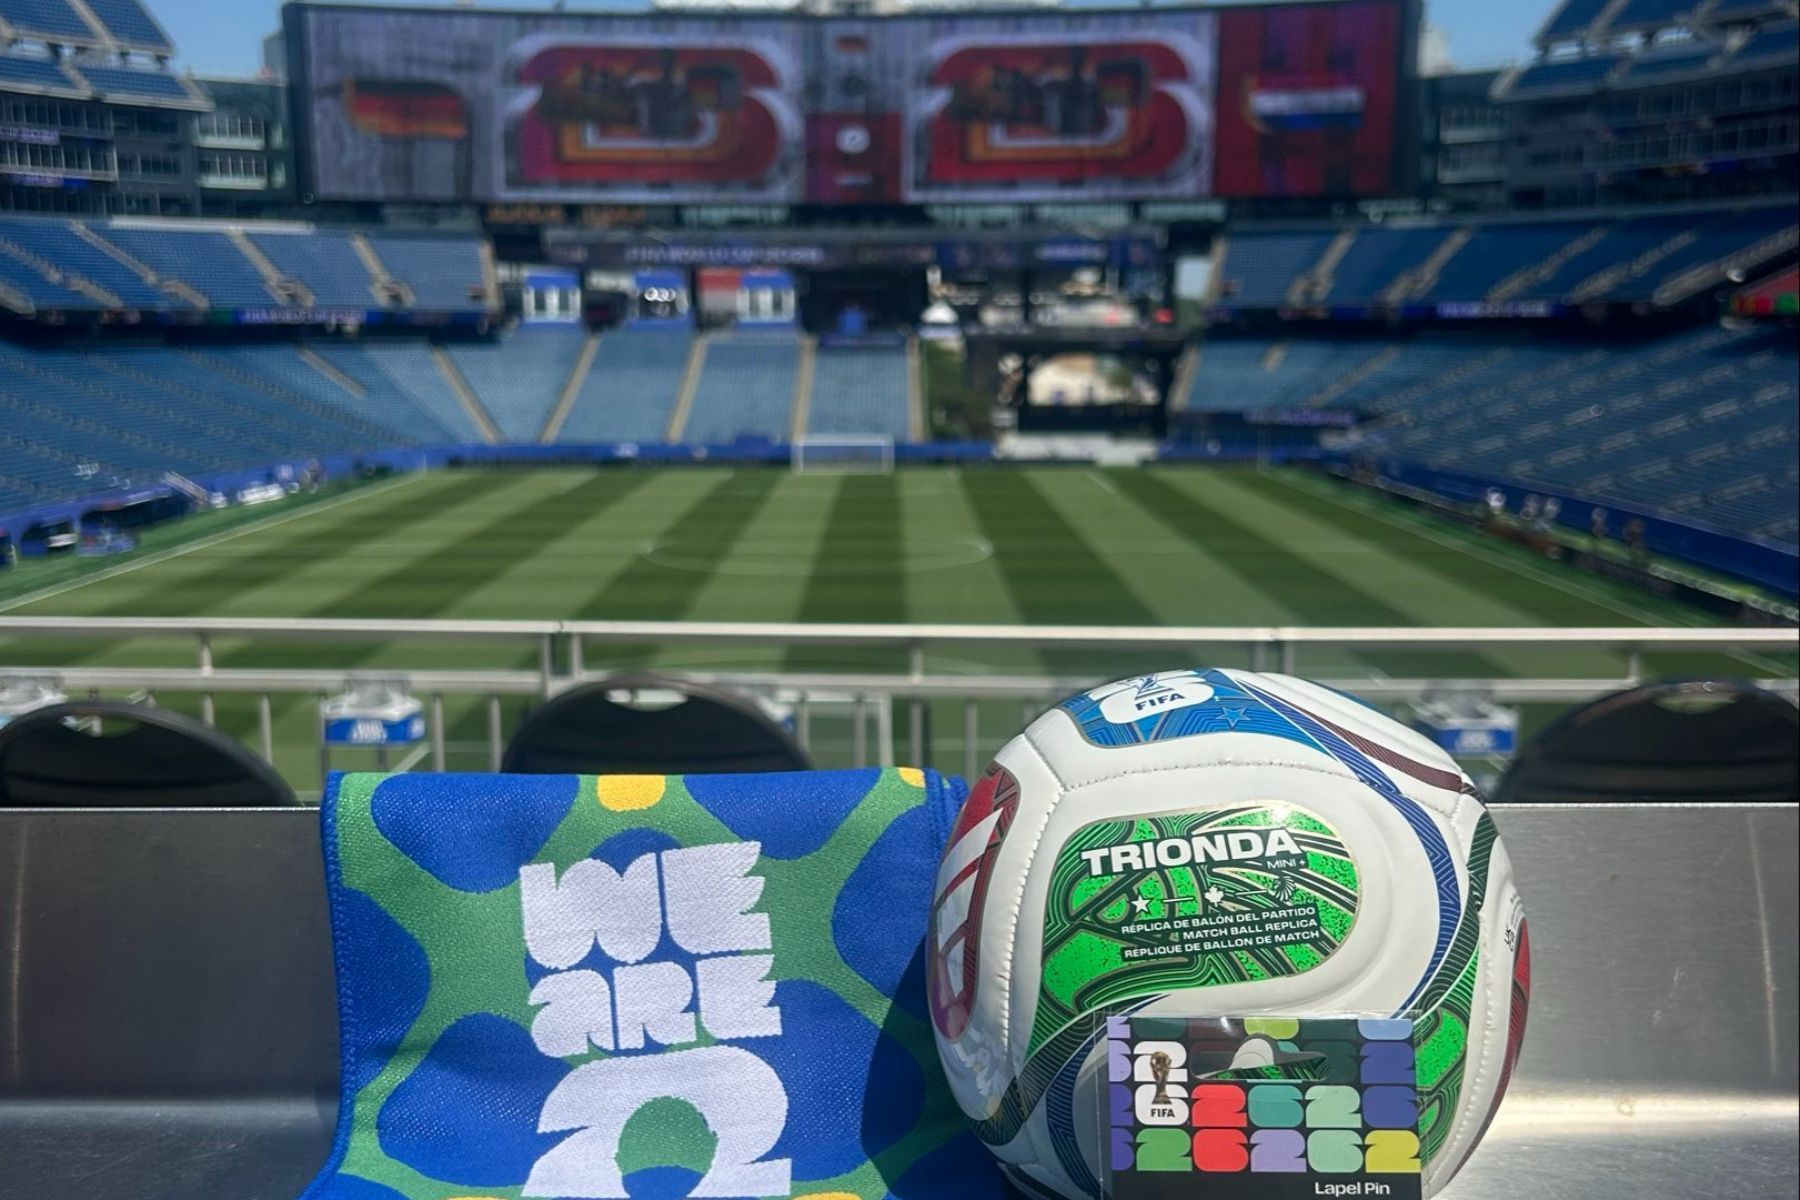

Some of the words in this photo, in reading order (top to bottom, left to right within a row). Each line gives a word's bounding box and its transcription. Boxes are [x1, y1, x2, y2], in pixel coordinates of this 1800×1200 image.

[1135, 693, 1186, 712] FIFA
[1081, 829, 1302, 876] TRIONDA
[1266, 858, 1297, 869] MINI
[519, 841, 773, 970] WE
[1173, 919, 1190, 929] DE
[1191, 914, 1234, 927] BALÓN
[1236, 913, 1261, 923] DEL
[1262, 907, 1316, 919] PARTIDO
[1182, 928, 1229, 940] MATCH
[1230, 924, 1263, 935] BALL
[1265, 918, 1318, 931] REPLICA
[1185, 942, 1201, 952] DE
[1203, 937, 1254, 949] BALLON
[1255, 936, 1272, 945] DE
[1274, 930, 1320, 942] MATCH
[528, 954, 783, 1058] ARE
[1150, 1108, 1176, 1118] FIFA
[1314, 1181, 1361, 1197] Lapel
[1364, 1181, 1390, 1195] Pin
